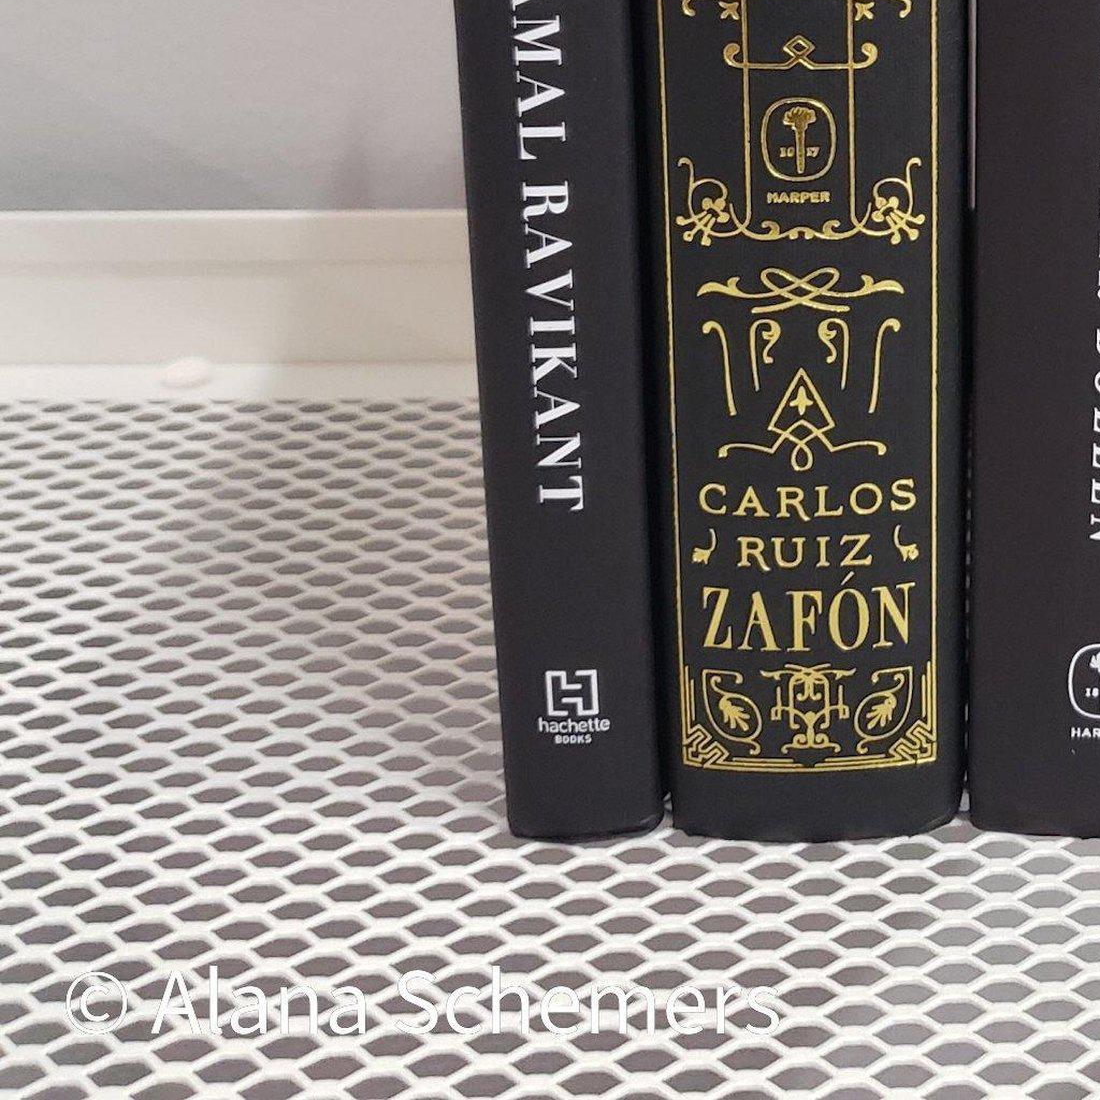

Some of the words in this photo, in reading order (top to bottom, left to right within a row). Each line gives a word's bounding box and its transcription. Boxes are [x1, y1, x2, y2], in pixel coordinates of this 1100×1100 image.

[767, 191, 830, 203] HARPER
[521, 181, 583, 511] RAVIKANT
[699, 478, 917, 522] CARLOS
[737, 534, 872, 571] RUIZ
[703, 572, 917, 652] ZAFÓN
[538, 716, 611, 734] hachette
[554, 734, 592, 744] BOOKS
